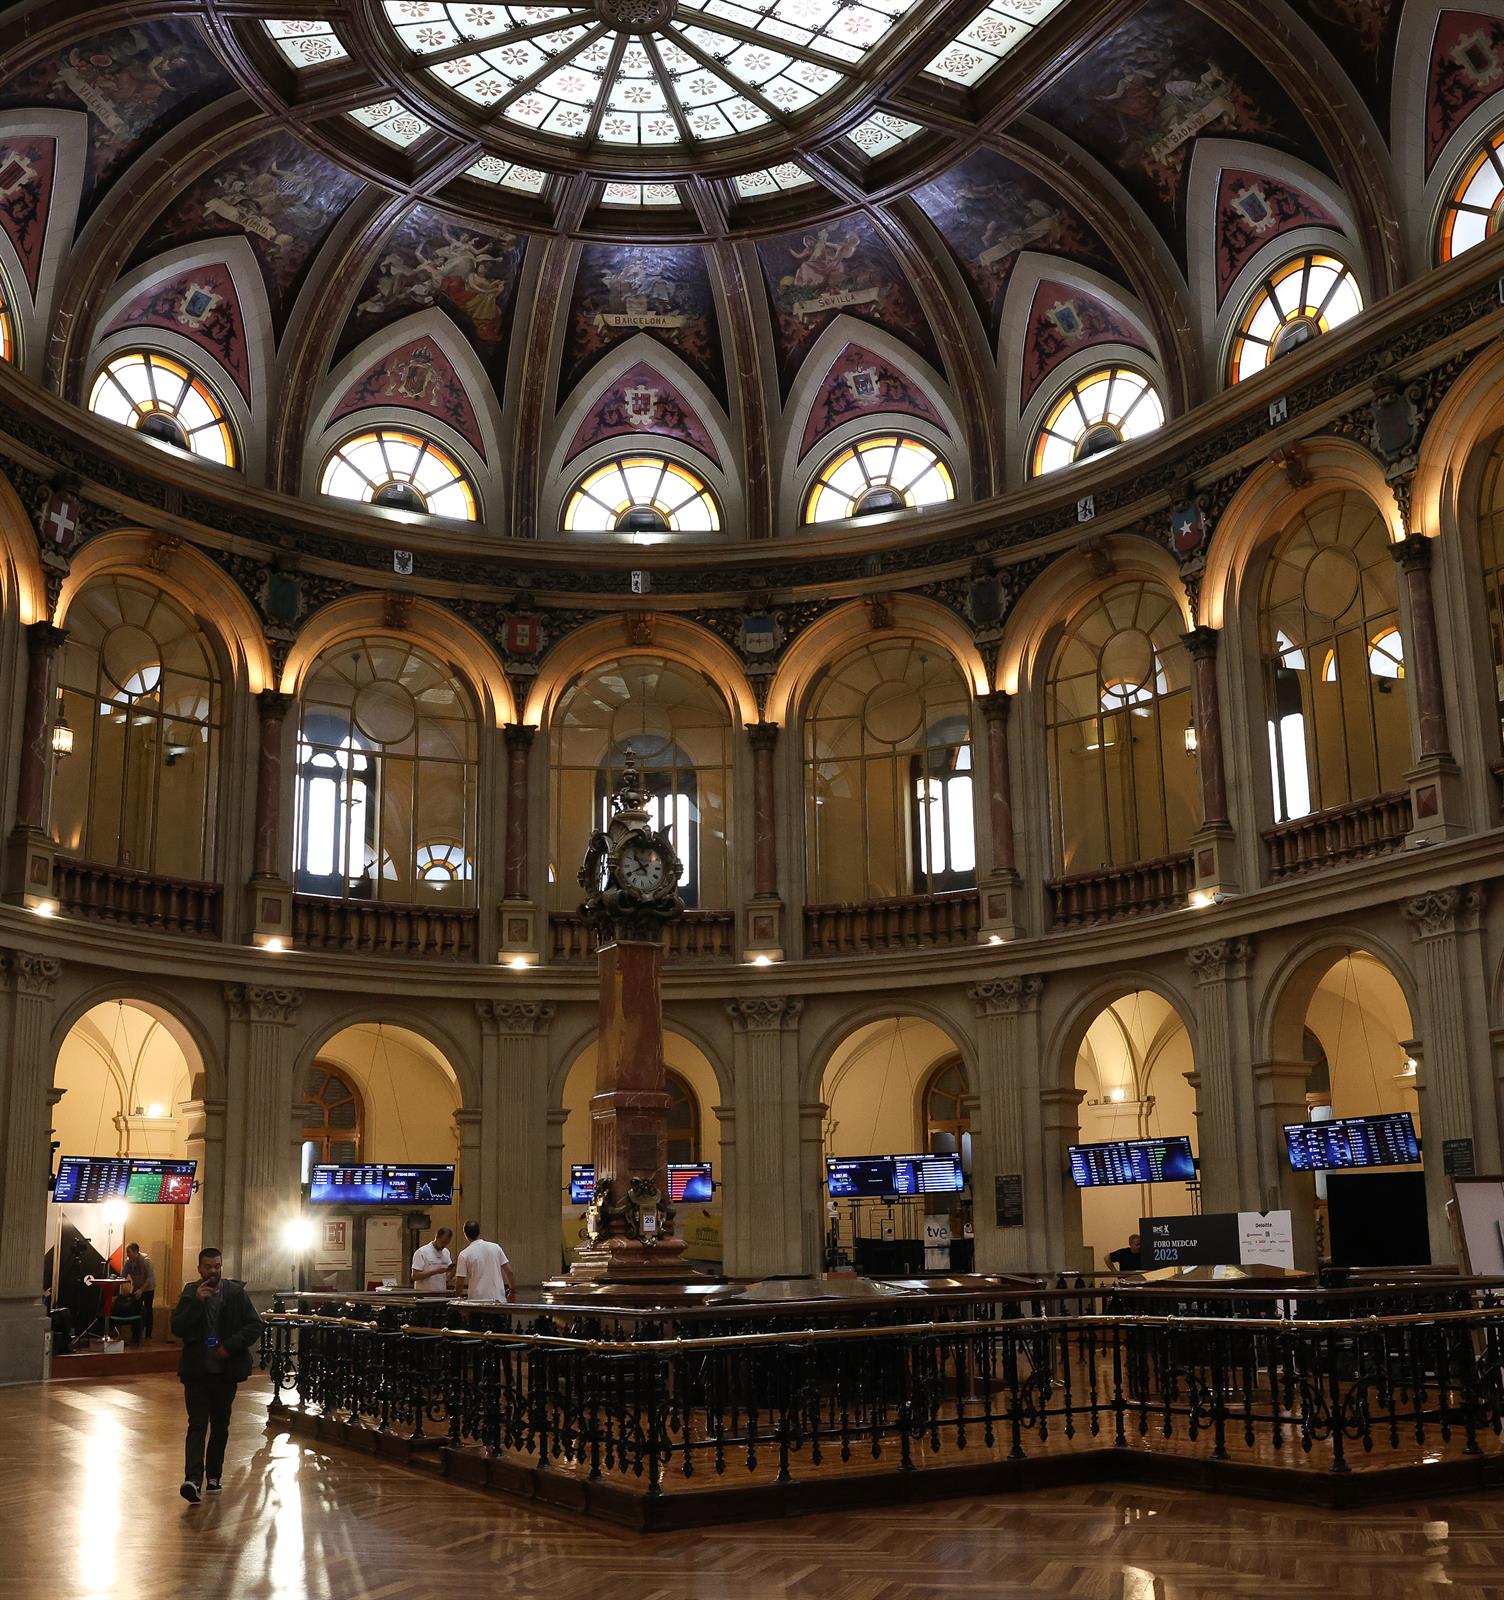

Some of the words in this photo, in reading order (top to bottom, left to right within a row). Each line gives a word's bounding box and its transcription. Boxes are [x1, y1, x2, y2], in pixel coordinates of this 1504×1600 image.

[819, 294, 855, 307] SEVILLA
[614, 316, 667, 325] BARCELONA
[926, 1226, 948, 1240] tve
[1153, 1240, 1170, 1248] FORO
[1171, 1239, 1198, 1247] MEDCAP
[1154, 1248, 1178, 1261] 2023
